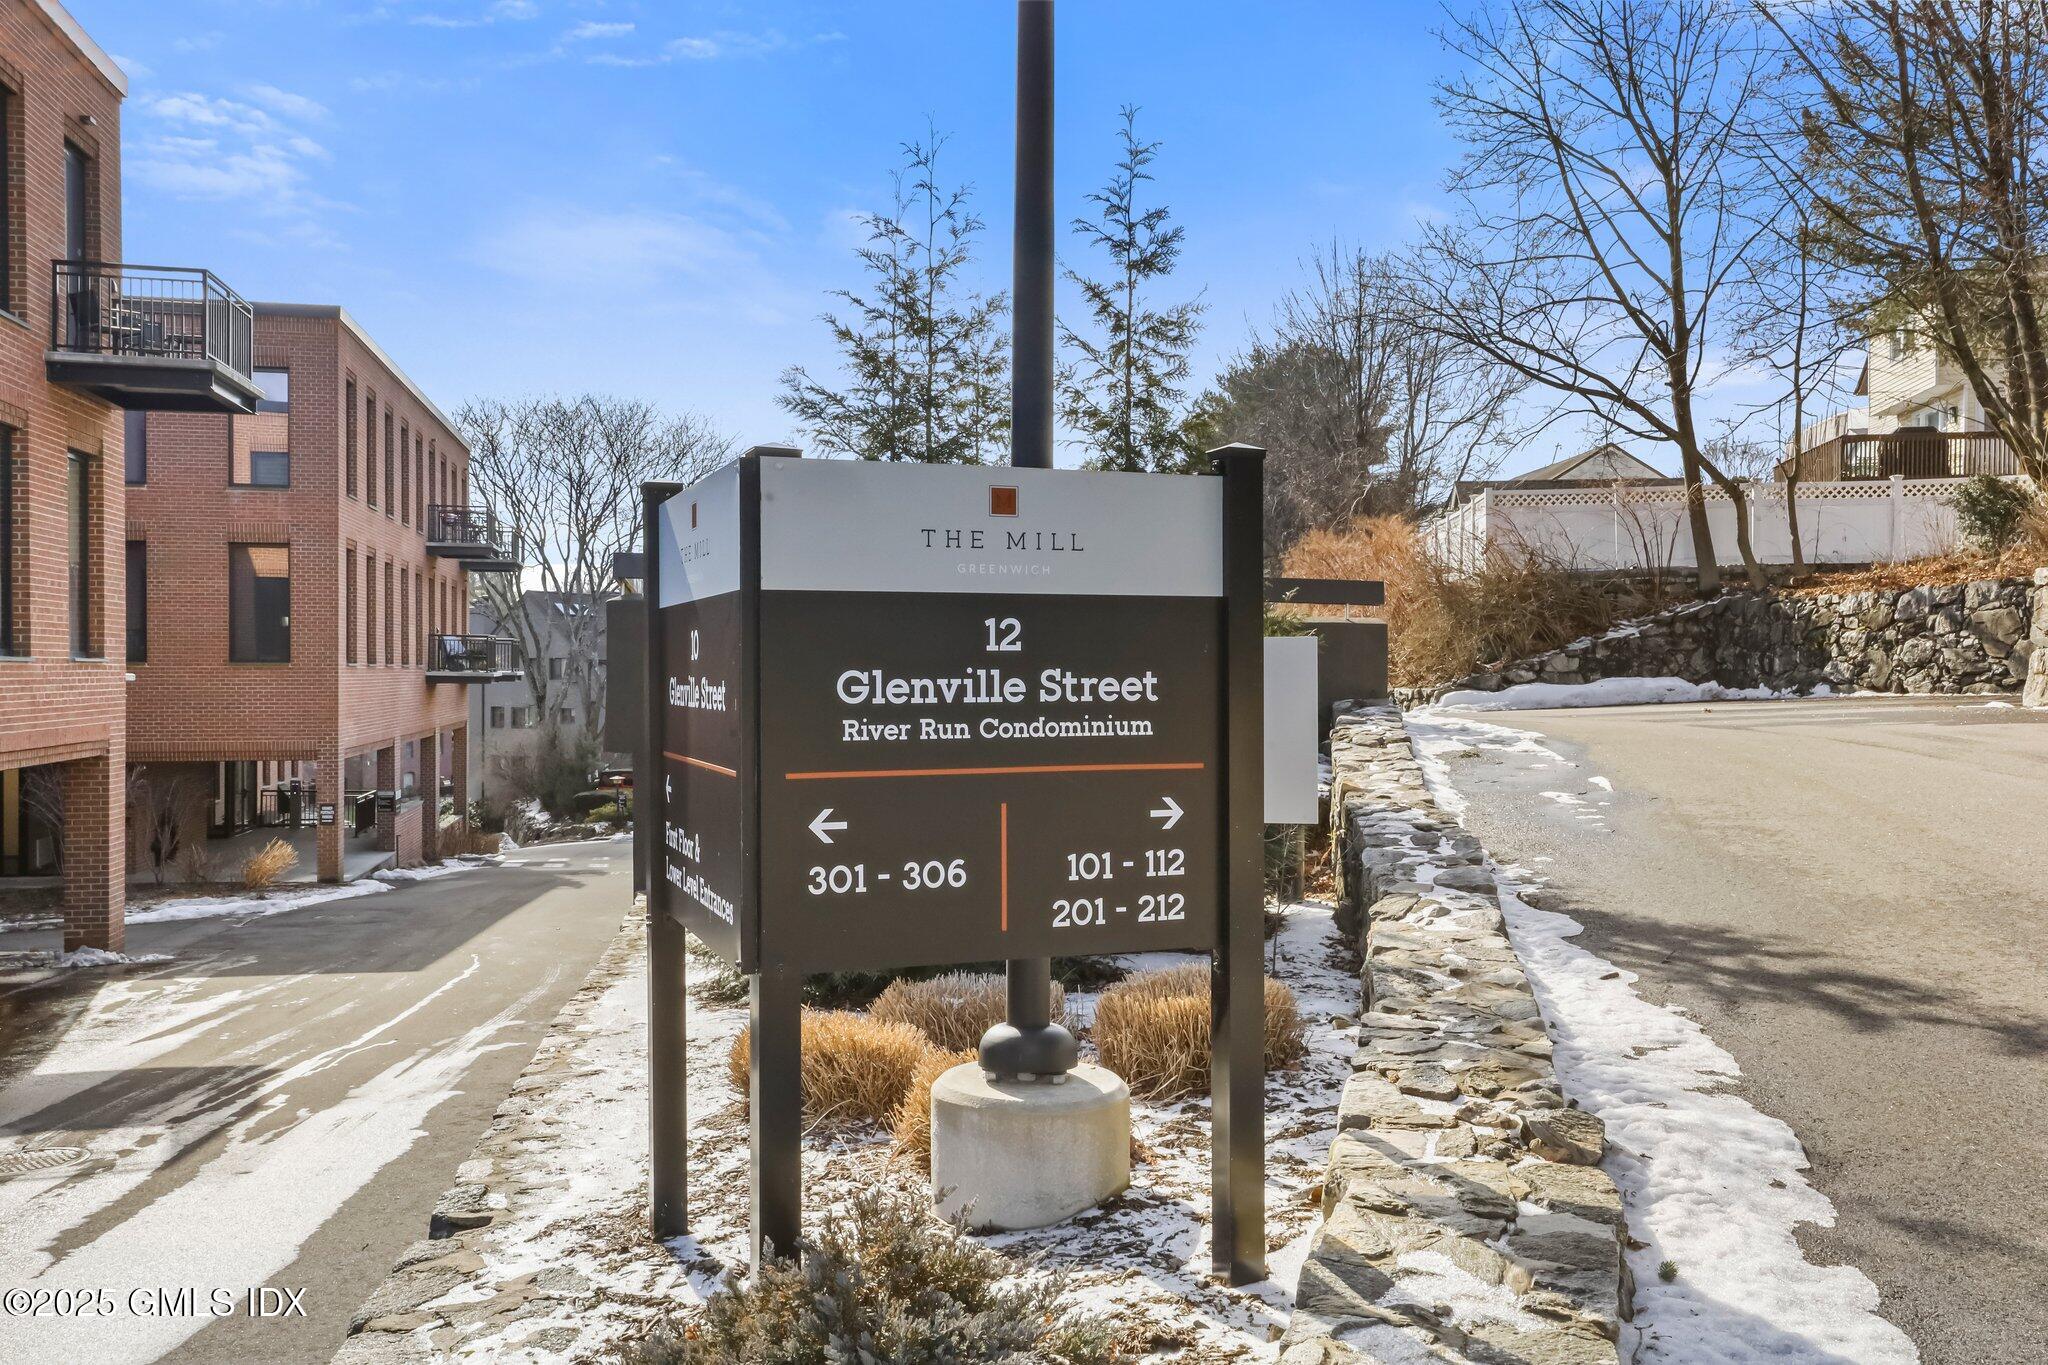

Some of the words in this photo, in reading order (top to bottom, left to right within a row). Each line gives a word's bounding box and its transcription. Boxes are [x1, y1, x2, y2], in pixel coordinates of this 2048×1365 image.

[920, 528, 984, 549] THE
[1006, 531, 1084, 551] MILL
[957, 563, 1051, 576] GREENWICH
[690, 629, 699, 661] 10
[984, 617, 1022, 652] 12
[669, 675, 700, 708] Glenville
[701, 676, 726, 711] Street
[836, 667, 1027, 705] Glenville
[1039, 668, 1159, 703] Street
[842, 717, 912, 741] River
[919, 718, 971, 740] Run
[979, 714, 1154, 739] Condominium
[665, 820, 678, 850] First
[678, 827, 694, 860] Floor
[695, 833, 701, 864] &
[807, 863, 867, 895] 301
[902, 859, 967, 890] 306
[1067, 851, 1114, 881] 101
[1145, 848, 1185, 877] 112
[665, 855, 682, 889] Lower
[683, 866, 699, 901] Level
[700, 874, 734, 926] Entrances
[1052, 897, 1106, 928] 201
[1137, 893, 1185, 923] 212
